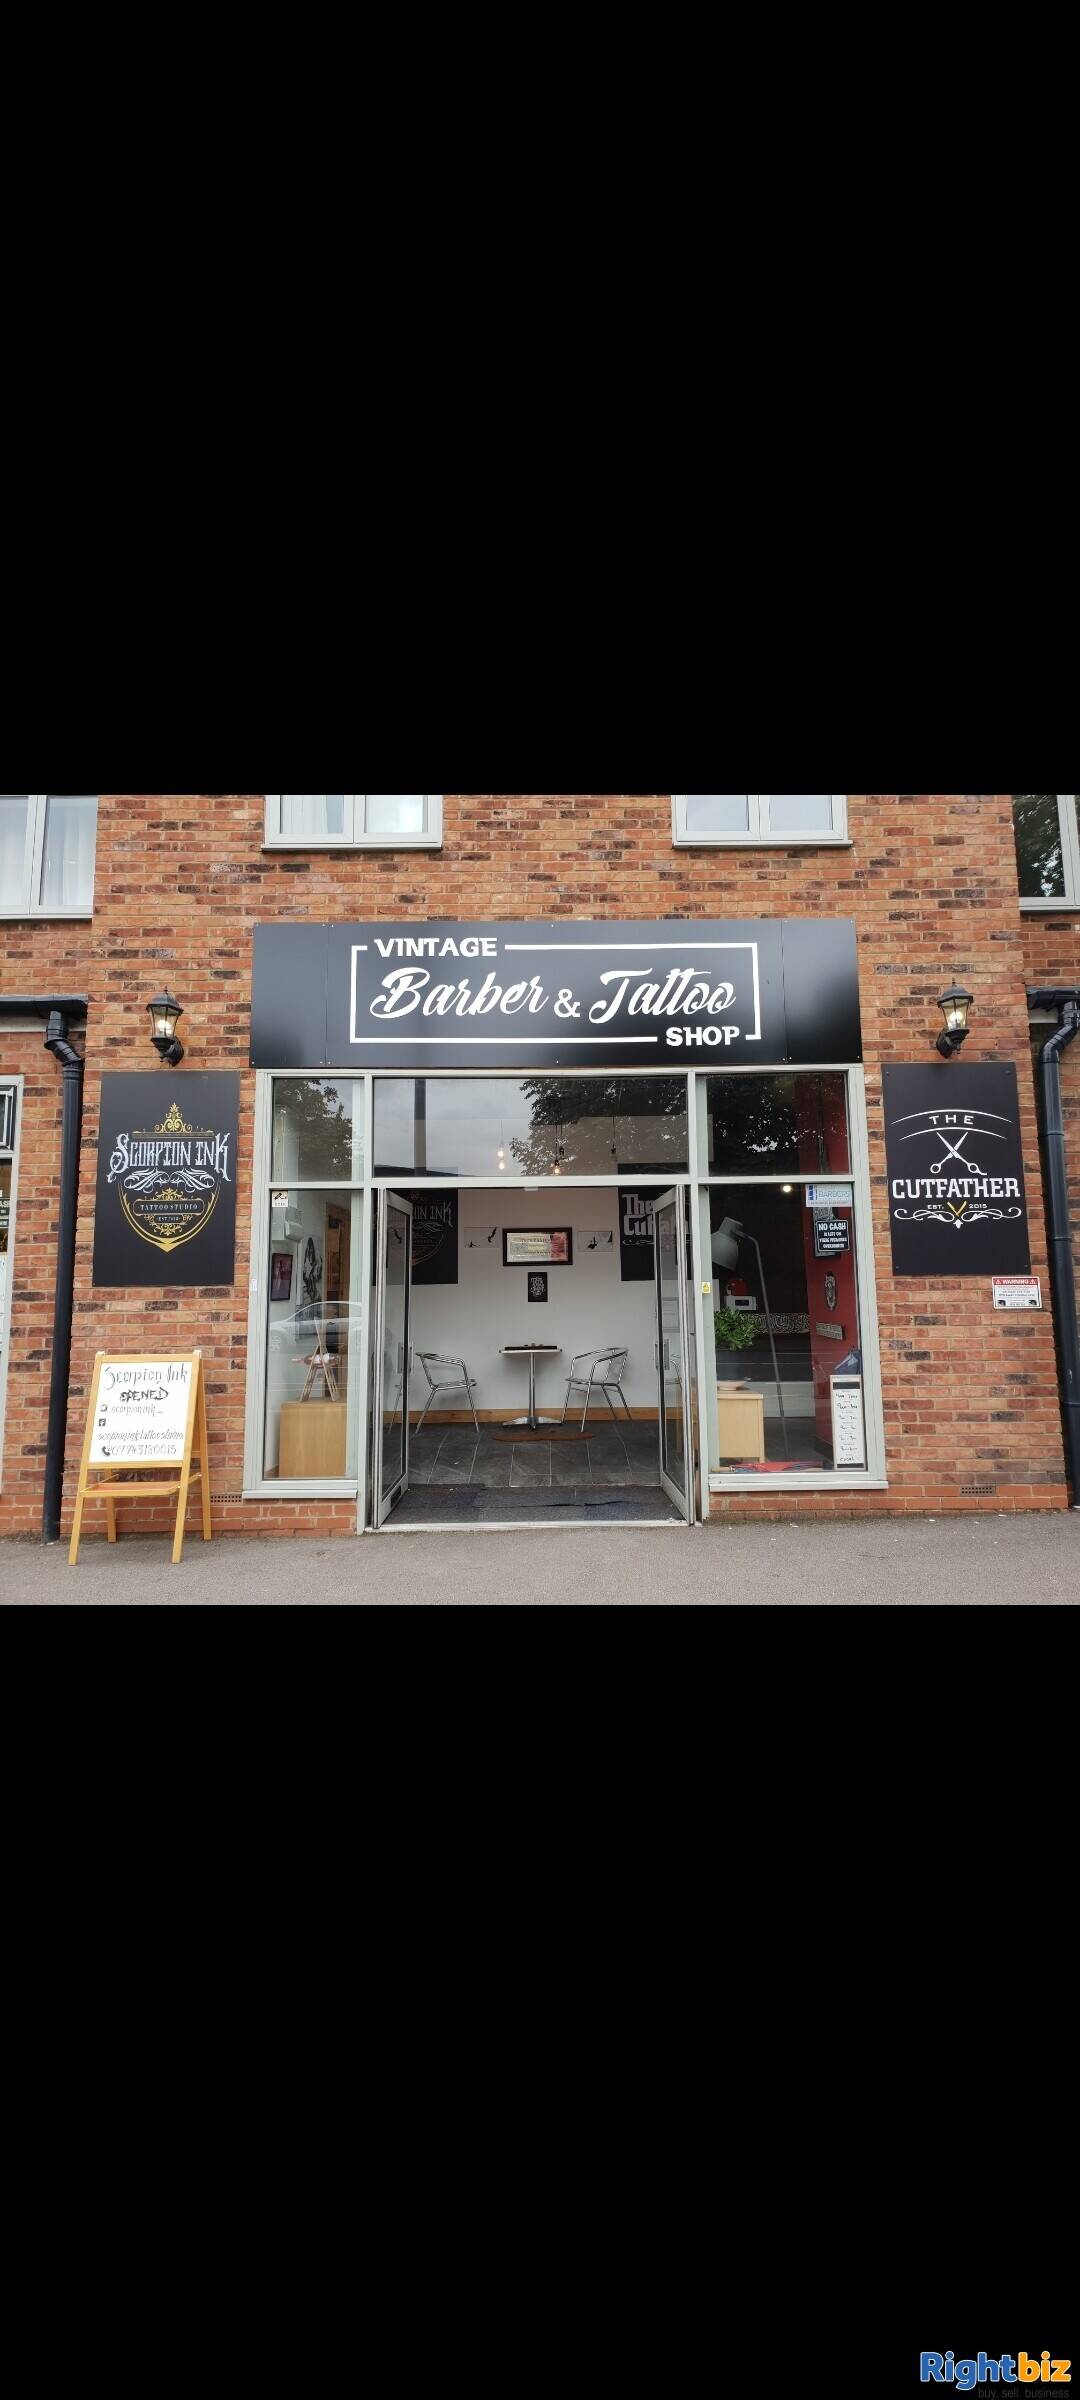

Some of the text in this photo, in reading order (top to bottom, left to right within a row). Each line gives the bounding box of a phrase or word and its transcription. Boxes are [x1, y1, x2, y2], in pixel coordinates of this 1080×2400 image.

[374, 937, 498, 958] VINTAGE
[369, 967, 737, 1024] Barber & Tattoo
[665, 1025, 740, 1047] SHOP
[928, 1114, 975, 1125] THE
[107, 1132, 232, 1183] SCORPION INK
[892, 1177, 1021, 1199] CUTFATHER
[622, 1194, 654, 1215] The
[819, 1222, 846, 1231] NO CASH
[103, 1362, 188, 1390] Scorpion Ink
